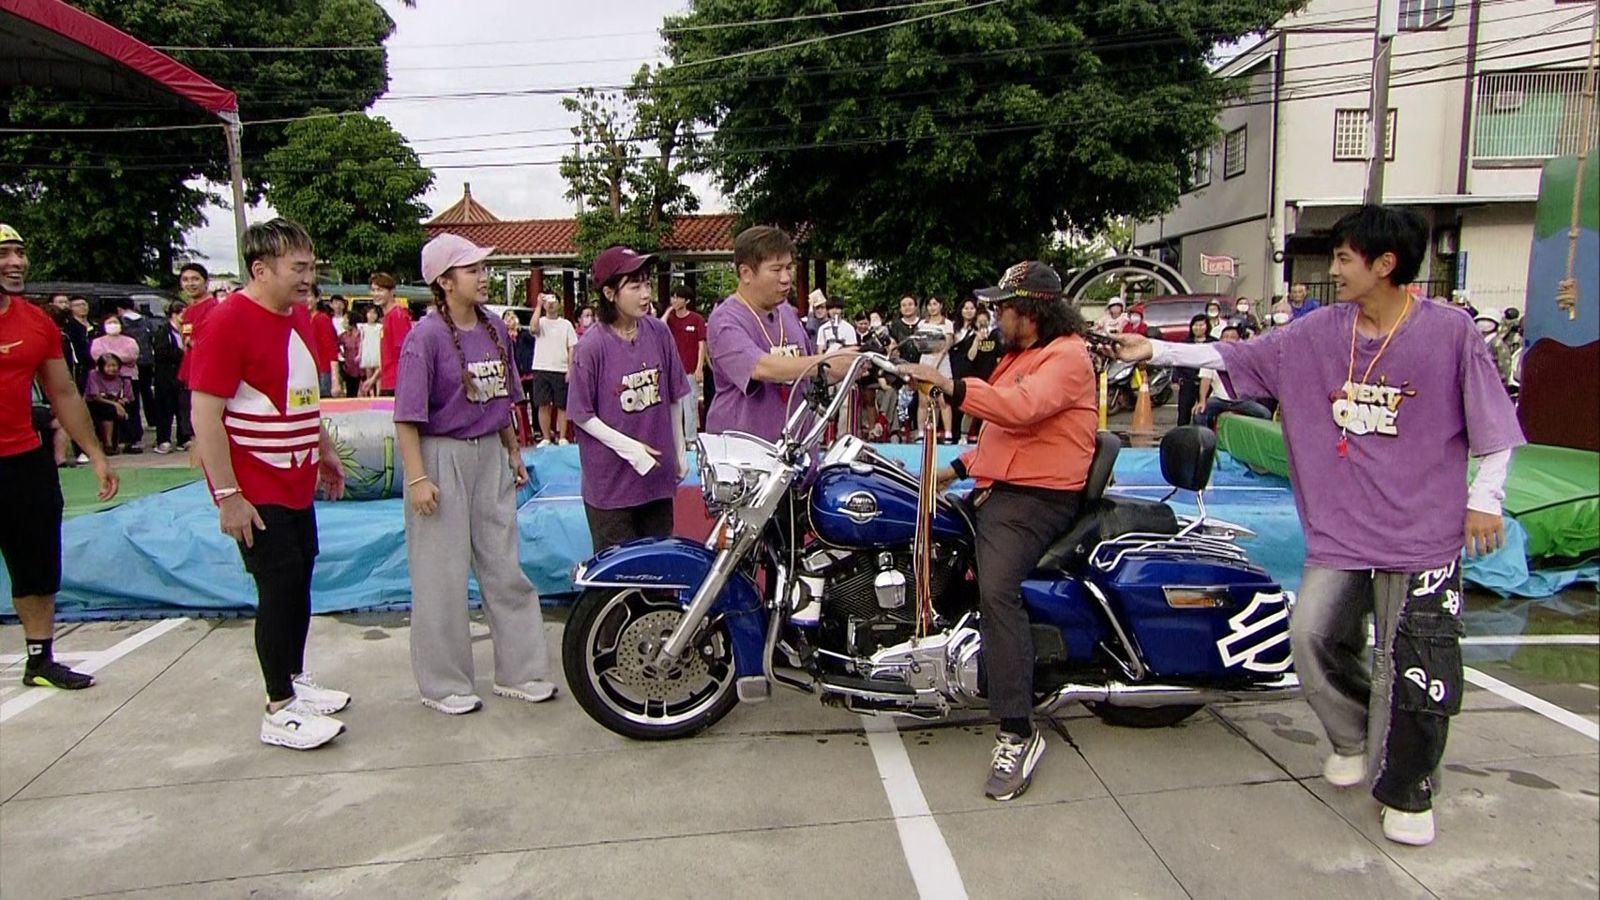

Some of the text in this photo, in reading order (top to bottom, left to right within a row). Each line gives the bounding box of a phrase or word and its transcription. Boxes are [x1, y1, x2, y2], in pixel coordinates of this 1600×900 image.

[467, 360, 503, 378] NEXT
[621, 368, 659, 390] NEXT
[620, 384, 662, 412] ONE
[1341, 380, 1402, 407] NEXT
[1331, 398, 1399, 436] ONE
